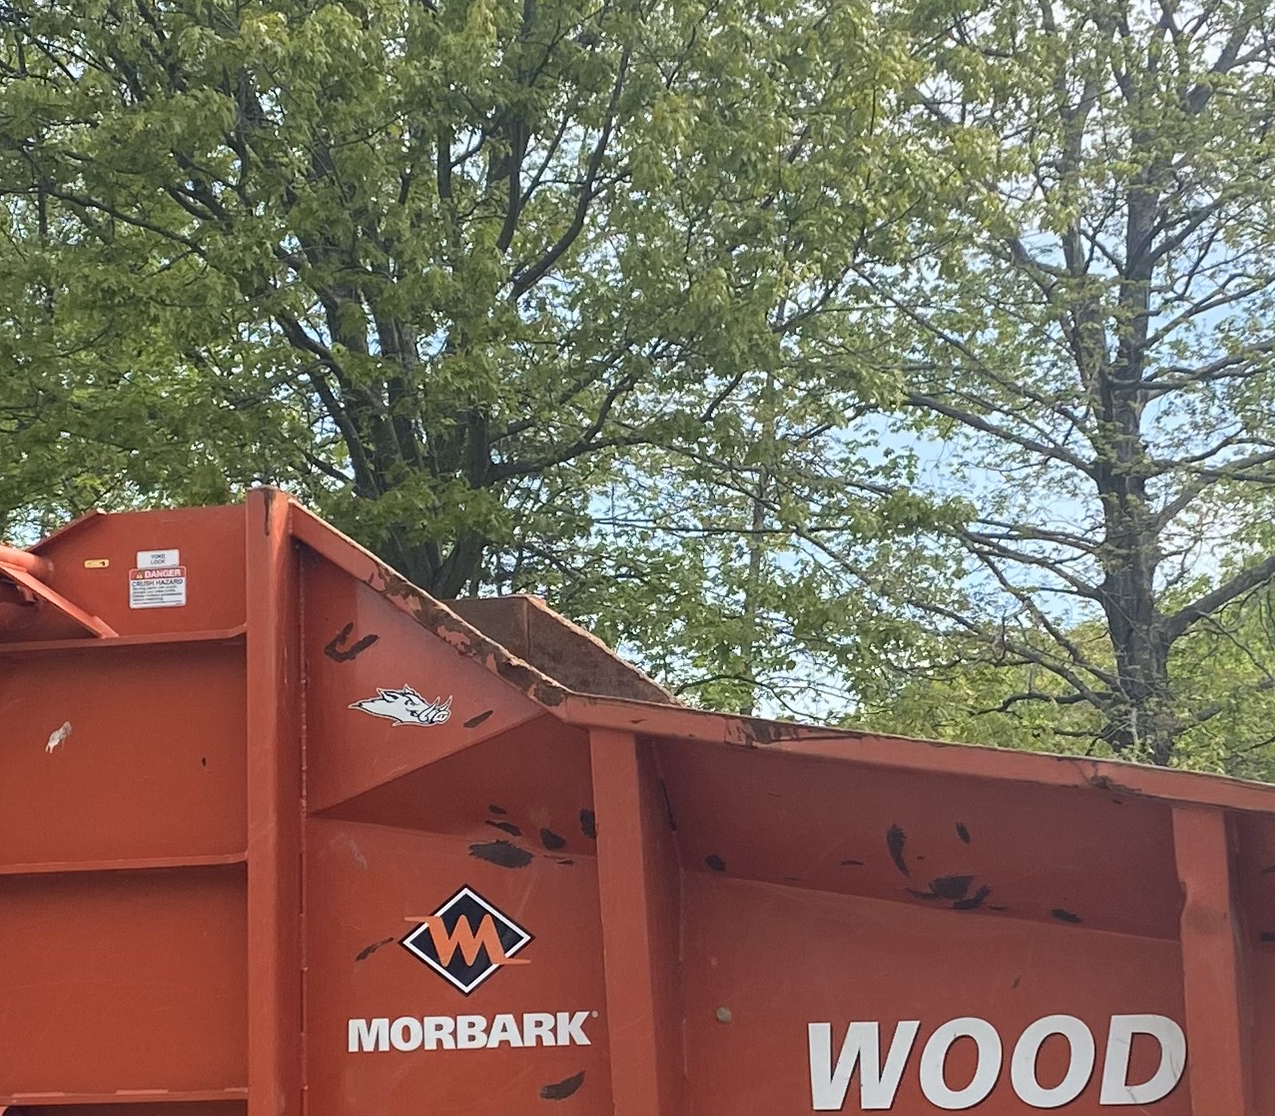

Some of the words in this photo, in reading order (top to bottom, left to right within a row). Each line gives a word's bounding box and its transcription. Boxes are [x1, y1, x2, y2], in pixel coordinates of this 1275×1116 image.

[144, 569, 181, 578] DANGER
[348, 1010, 592, 1053] MORBARK
[808, 1014, 1187, 1111] WOOD
